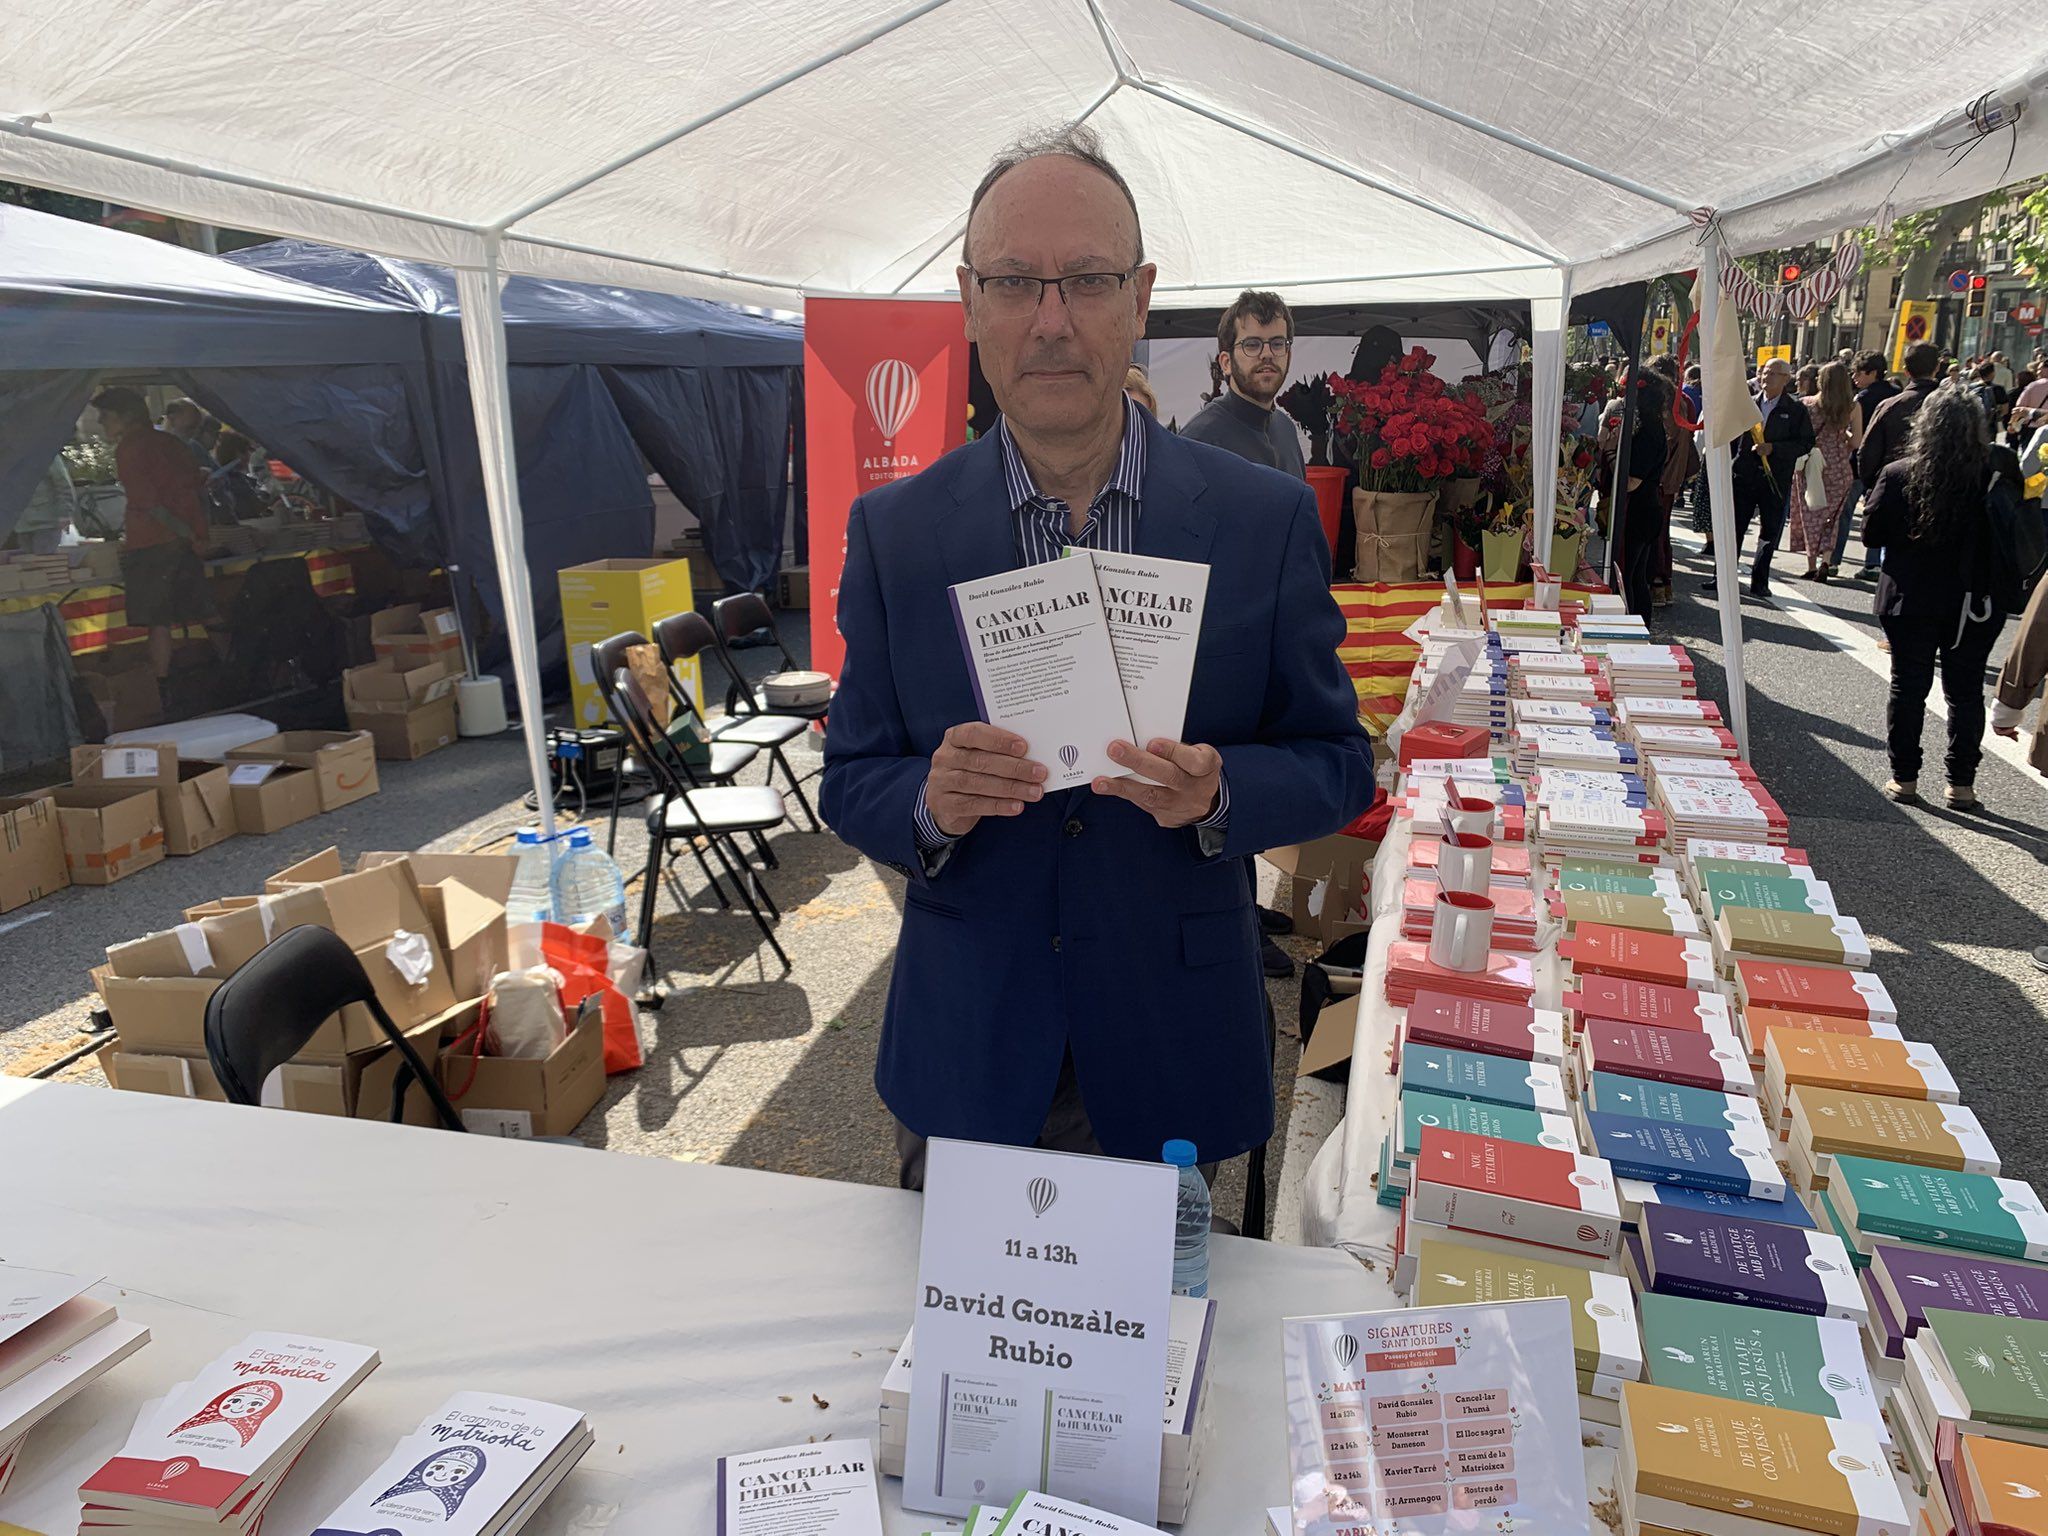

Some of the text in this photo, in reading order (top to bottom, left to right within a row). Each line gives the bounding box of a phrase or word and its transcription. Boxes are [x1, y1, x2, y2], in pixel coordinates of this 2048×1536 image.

[863, 455, 920, 469] ALBADA
[1137, 569, 1160, 579] Rubio
[968, 577, 1045, 602] David González Rubio
[1099, 586, 1193, 613] NCELAR
[1471, 1151, 1481, 1169] NOU
[1484, 1142, 1497, 1185] TESTAMENT
[1919, 1173, 1949, 1215] DE VIATGE
[1448, 1192, 1458, 1222] TESTAMENT
[1947, 1199, 1963, 1217] AMB
[1603, 1229, 1611, 1247] ALBADA
[1707, 1228, 1720, 1255] MADURAI
[1005, 1239, 1078, 1265] 11 a 13h
[1703, 1246, 1712, 1258] FRA
[1728, 1227, 1750, 1275] DE VIATGE
[1750, 1258, 1766, 1280] AMB
[1508, 1271, 1522, 1298] VIAJE
[1970, 1268, 2006, 1316] DE VIATGE
[923, 1284, 1146, 1340] David Gonzàlez
[1367, 1322, 1453, 1340] SIGNATURES
[1751, 1328, 1763, 1336] 4
[1381, 1336, 1438, 1349] SANT JORDI
[248, 1348, 266, 1360] El
[302, 1356, 321, 1367] de
[322, 1358, 337, 1370] la
[988, 1334, 1073, 1370] Rubio
[1750, 1339, 1773, 1380] JESÚS
[1700, 1337, 1718, 1386] FRAY ARUN
[1709, 1334, 1729, 1392] DE MADURAI
[1733, 1336, 1760, 1398] DE VIAJE
[1333, 1378, 1366, 1393] MATÍ
[1378, 1400, 1400, 1410] David
[1396, 1410, 1417, 1418] Rubio
[445, 1410, 545, 1436] El camino de la
[1057, 1407, 1123, 1424] CANCELAR
[1057, 1419, 1113, 1434] lo HUMANO
[1386, 1429, 1429, 1439] Montserrat
[1455, 1428, 1505, 1438] El lloc sagrat
[1391, 1441, 1426, 1450] Dameson
[1730, 1420, 1757, 1469] DE VIAJE
[1749, 1422, 1775, 1455] JESÚS
[738, 1457, 762, 1468] David
[799, 1450, 823, 1459] Rubio
[1488, 1450, 1497, 1458] de
[1498, 1450, 1506, 1458] la
[1384, 1464, 1437, 1476] Xavier Tarré
[1461, 1463, 1505, 1473] Matrioixca
[1760, 1453, 1779, 1481] CON
[147, 1481, 169, 1489] ALBADA
[1494, 1484, 1504, 1492] de
[1399, 1495, 1442, 1504] Armengou
[1033, 1501, 1058, 1513] David
[1057, 1505, 1094, 1523] González
[1094, 1519, 1120, 1532] Rubio
